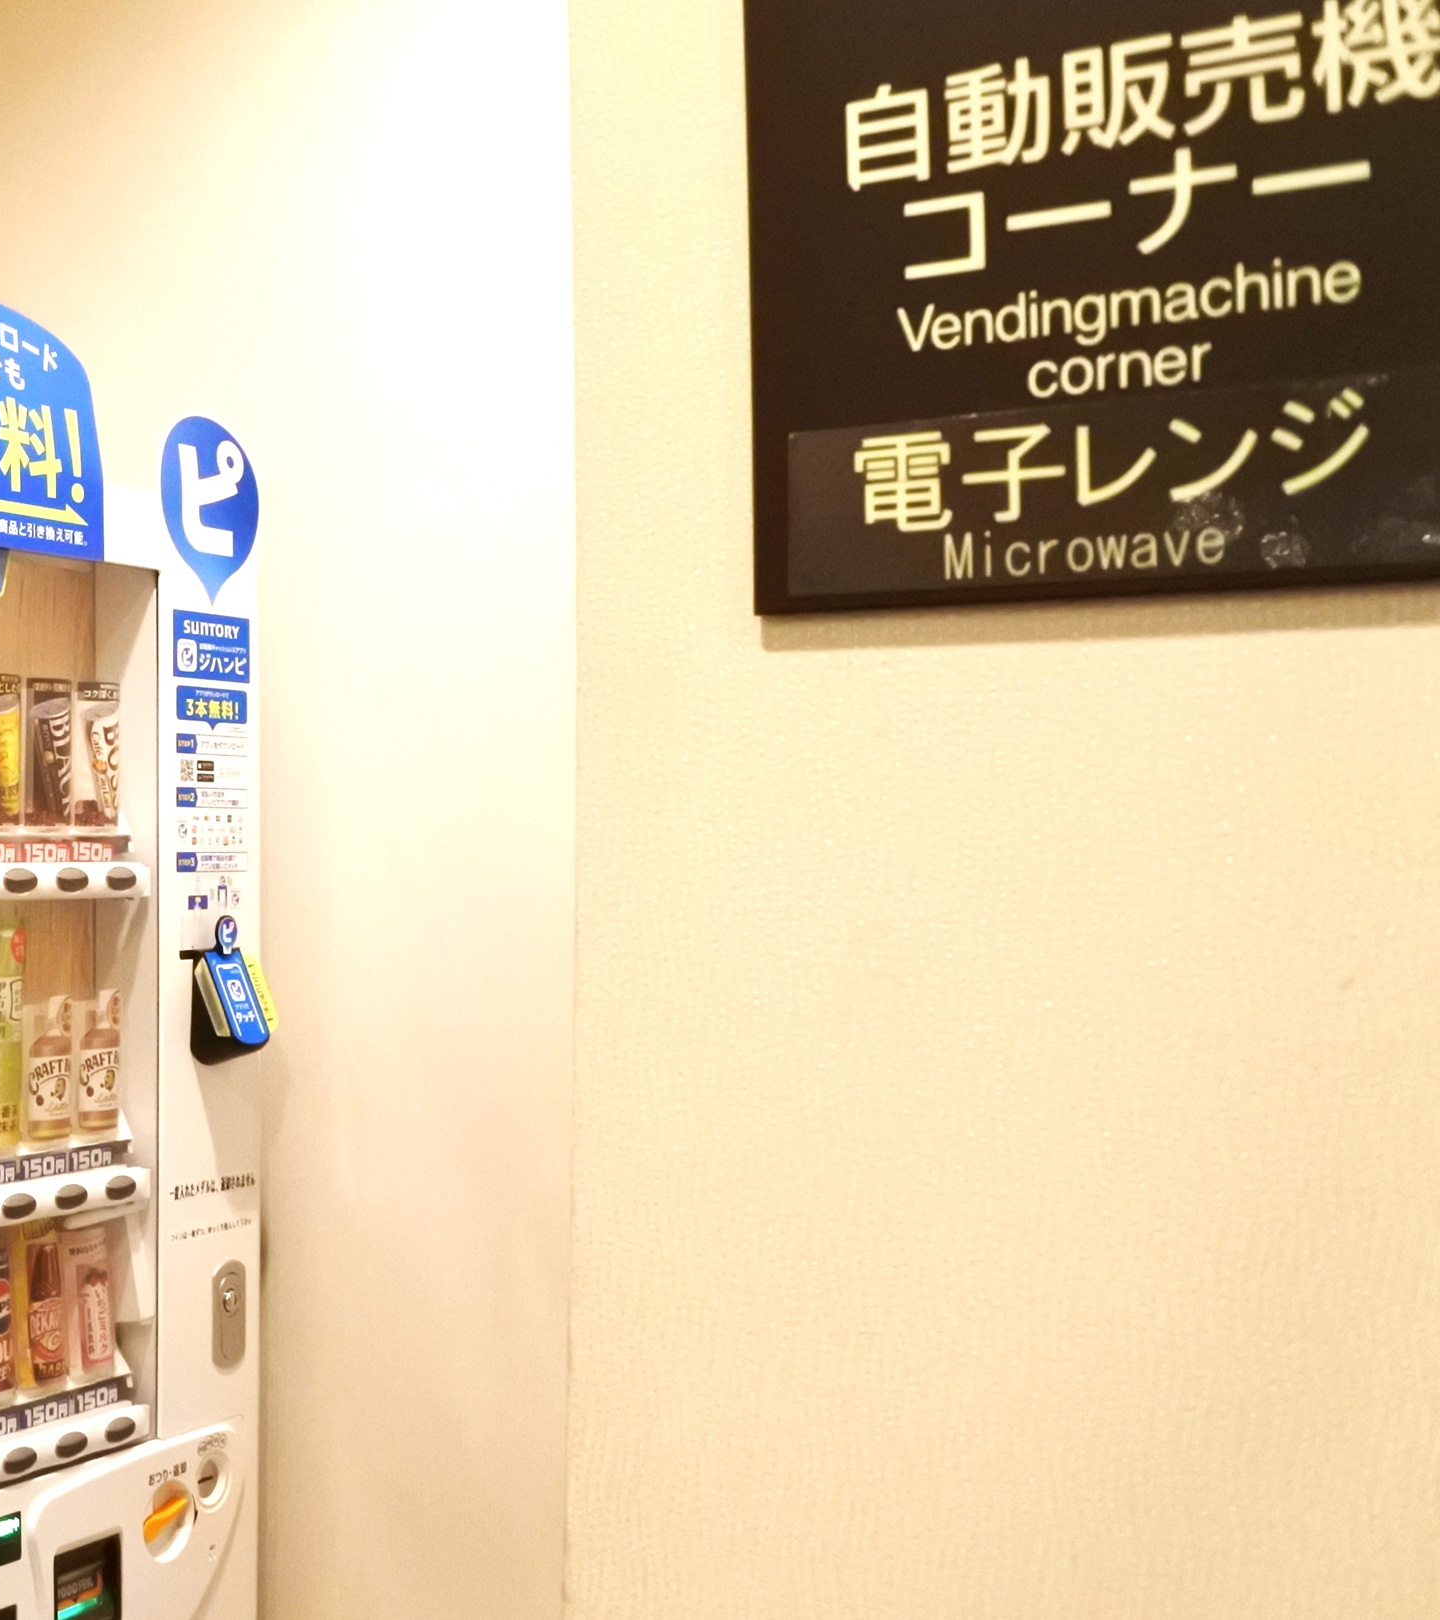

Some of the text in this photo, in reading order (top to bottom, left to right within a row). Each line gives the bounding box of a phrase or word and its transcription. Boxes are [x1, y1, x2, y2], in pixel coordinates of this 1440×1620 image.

[845, 0, 1440, 191] 自動販売機
[904, 147, 1371, 280] コーナー
[898, 258, 1361, 352] Vendingmachine
[1028, 343, 1212, 397] corner
[854, 387, 1370, 533] 電子レンジ
[178, 440, 244, 557] ピ
[943, 527, 1225, 580] Microwave
[183, 619, 240, 640] SUNTORY
[199, 653, 248, 676] ジハンピ
[185, 698, 239, 721] 3本無料!
[23, 842, 69, 862] 150円
[72, 841, 113, 862] 150円
[22, 1158, 65, 1180] 150円
[70, 1150, 112, 1172] 150円
[77, 1387, 118, 1412] 150円
[25, 1402, 68, 1429] 150円
